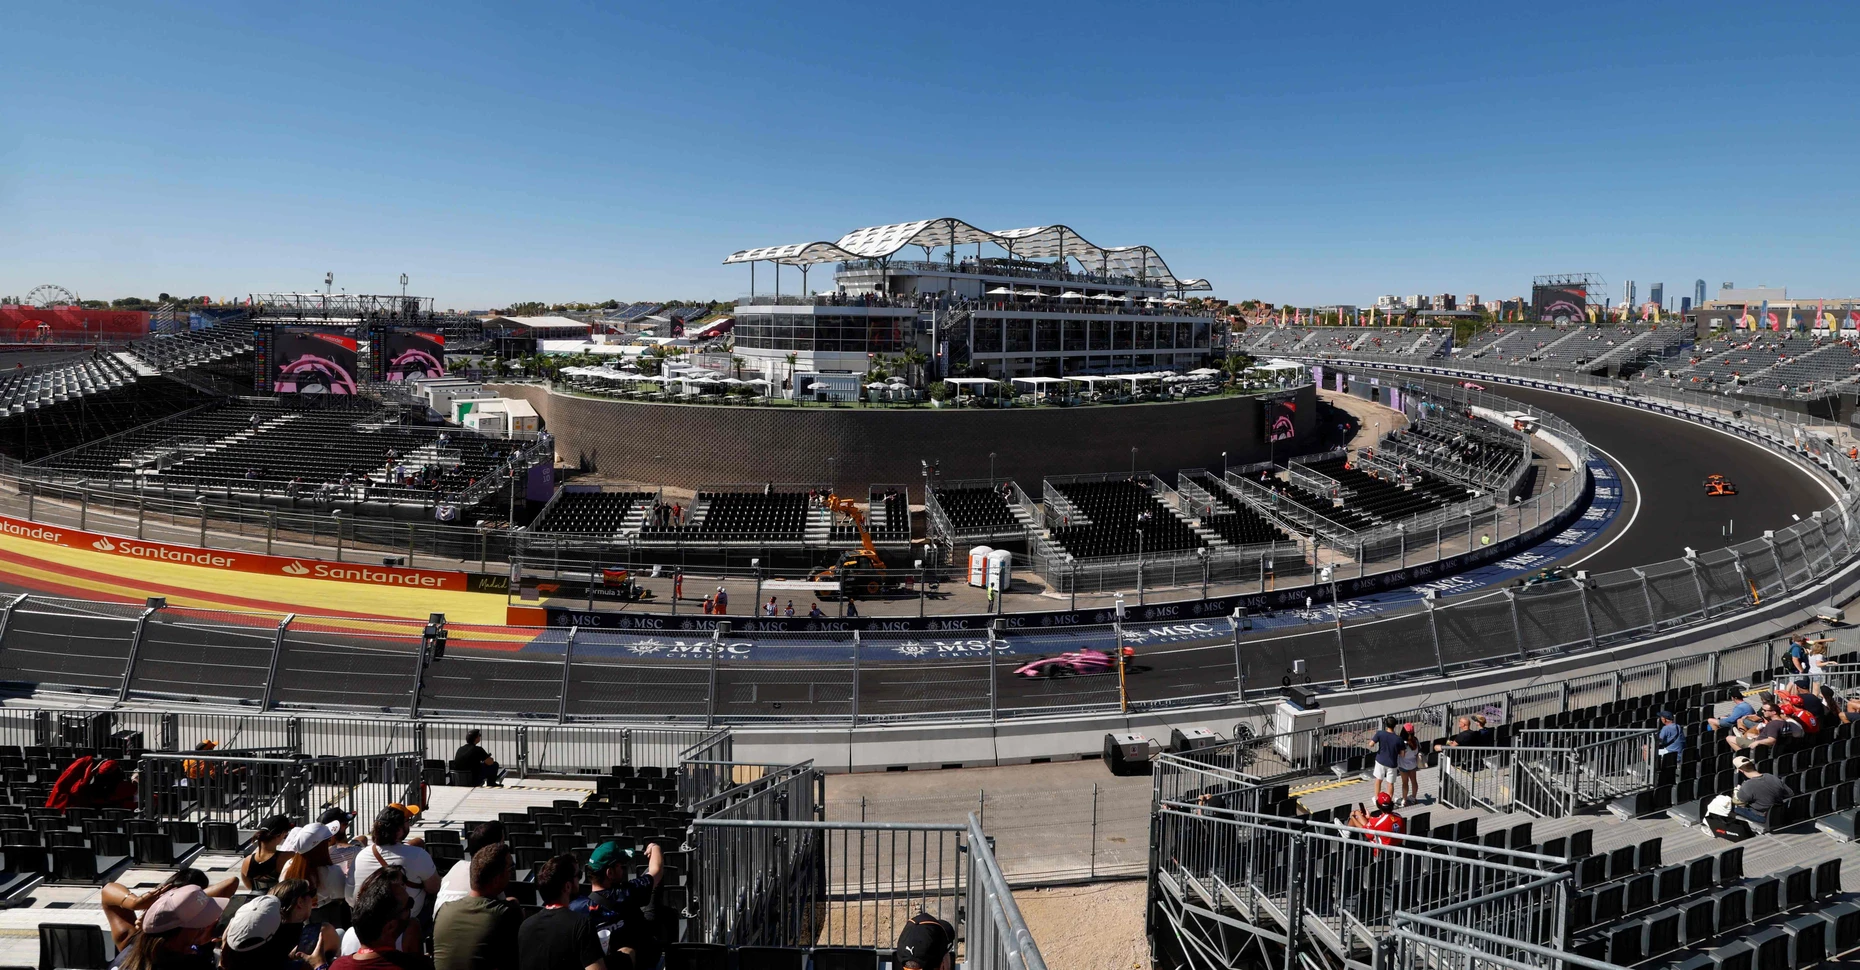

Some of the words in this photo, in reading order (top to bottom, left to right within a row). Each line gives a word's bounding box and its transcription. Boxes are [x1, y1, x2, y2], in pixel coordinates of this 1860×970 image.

[118, 542, 236, 567] Santander
[314, 564, 447, 587] Santander
[1390, 572, 1407, 583] MSC
[1360, 578, 1376, 589] MSC
[1247, 595, 1268, 607] MSC
[1288, 590, 1307, 601] MSC
[1156, 605, 1179, 617] MSC
[1204, 600, 1226, 612] MSC
[571, 614, 600, 626] MSC
[1054, 614, 1079, 625] MSC
[1107, 610, 1131, 621] MC
[634, 618, 663, 629] MSC
[759, 622, 788, 631] MSC
[821, 622, 849, 631] MSC
[882, 621, 910, 631] MSC
[942, 620, 969, 630] MSC
[1148, 623, 1214, 637] MSC
[669, 641, 753, 654] MSC
[933, 639, 1011, 652] MSC
